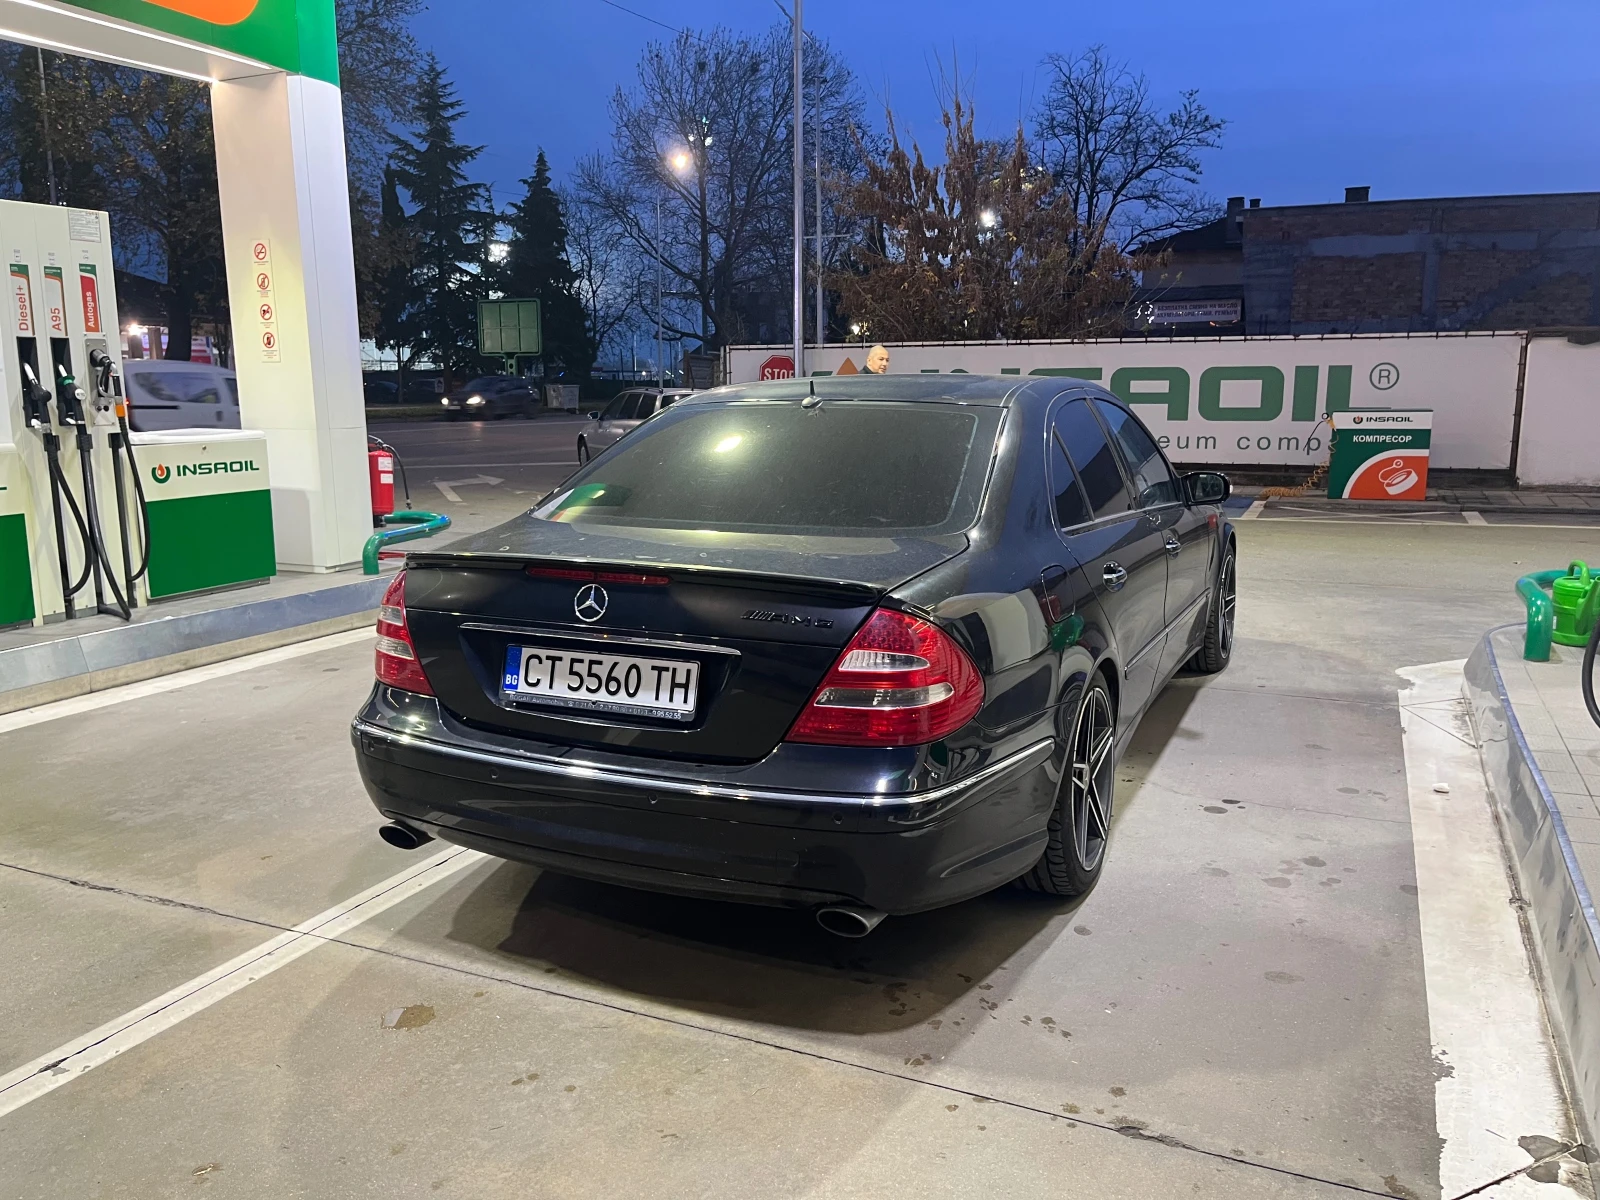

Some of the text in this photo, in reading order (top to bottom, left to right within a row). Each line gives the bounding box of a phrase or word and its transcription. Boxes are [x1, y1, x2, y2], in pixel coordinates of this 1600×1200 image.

[16, 285, 29, 331] Diesel+
[50, 307, 62, 331] A95
[86, 291, 95, 328] Autogas
[1237, 434, 1323, 456] comp
[1353, 435, 1412, 443] КОМПРЕСОР
[176, 460, 260, 477] INSAOIL
[505, 674, 518, 685] BG
[523, 654, 692, 704] CT 5560 TH
